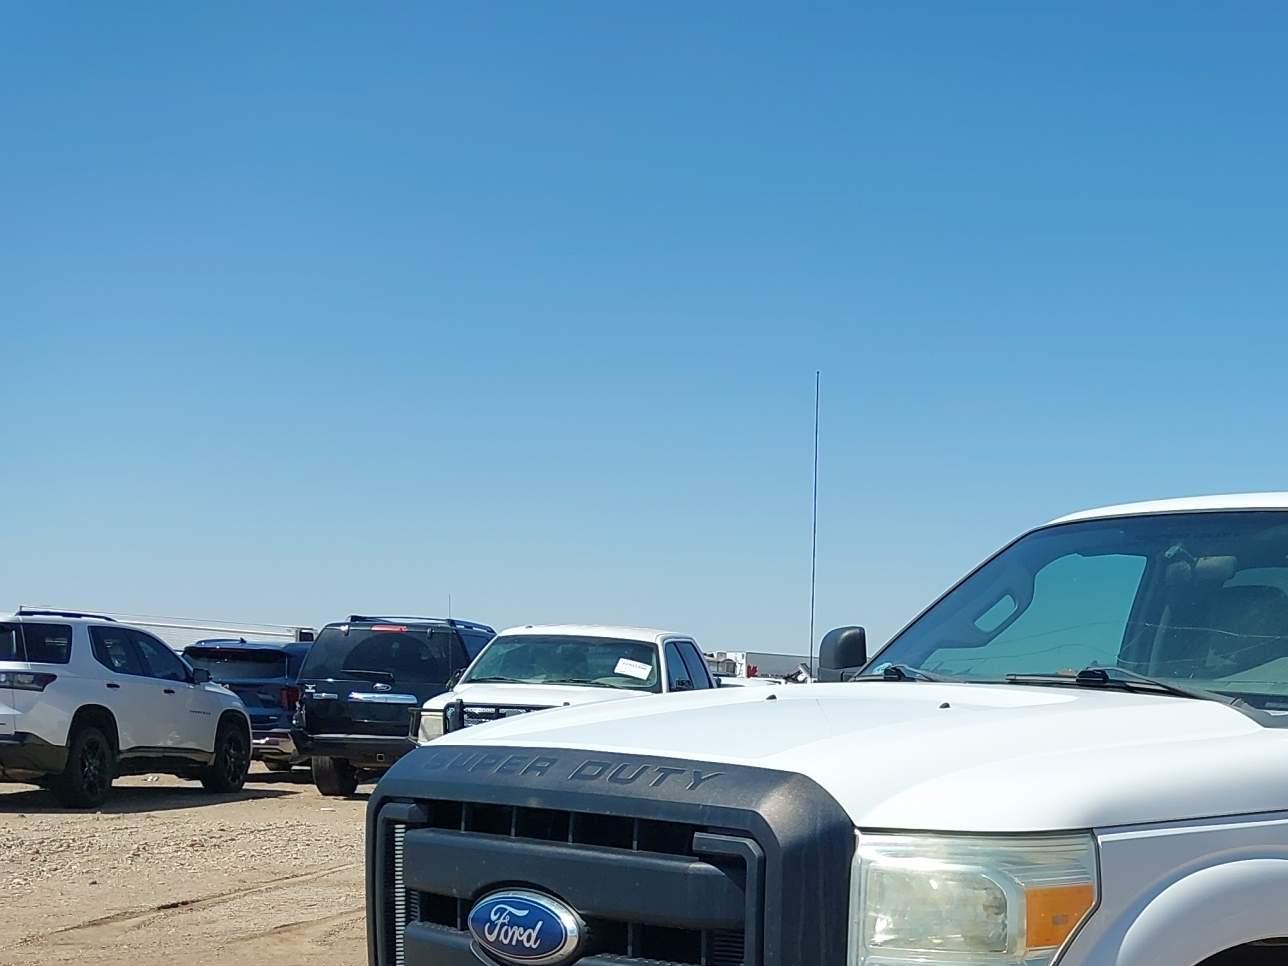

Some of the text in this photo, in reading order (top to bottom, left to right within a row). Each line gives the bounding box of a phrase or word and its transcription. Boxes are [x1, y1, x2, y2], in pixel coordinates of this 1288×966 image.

[424, 753, 725, 790] SUPER DUTY
[484, 904, 543, 949] Ford
